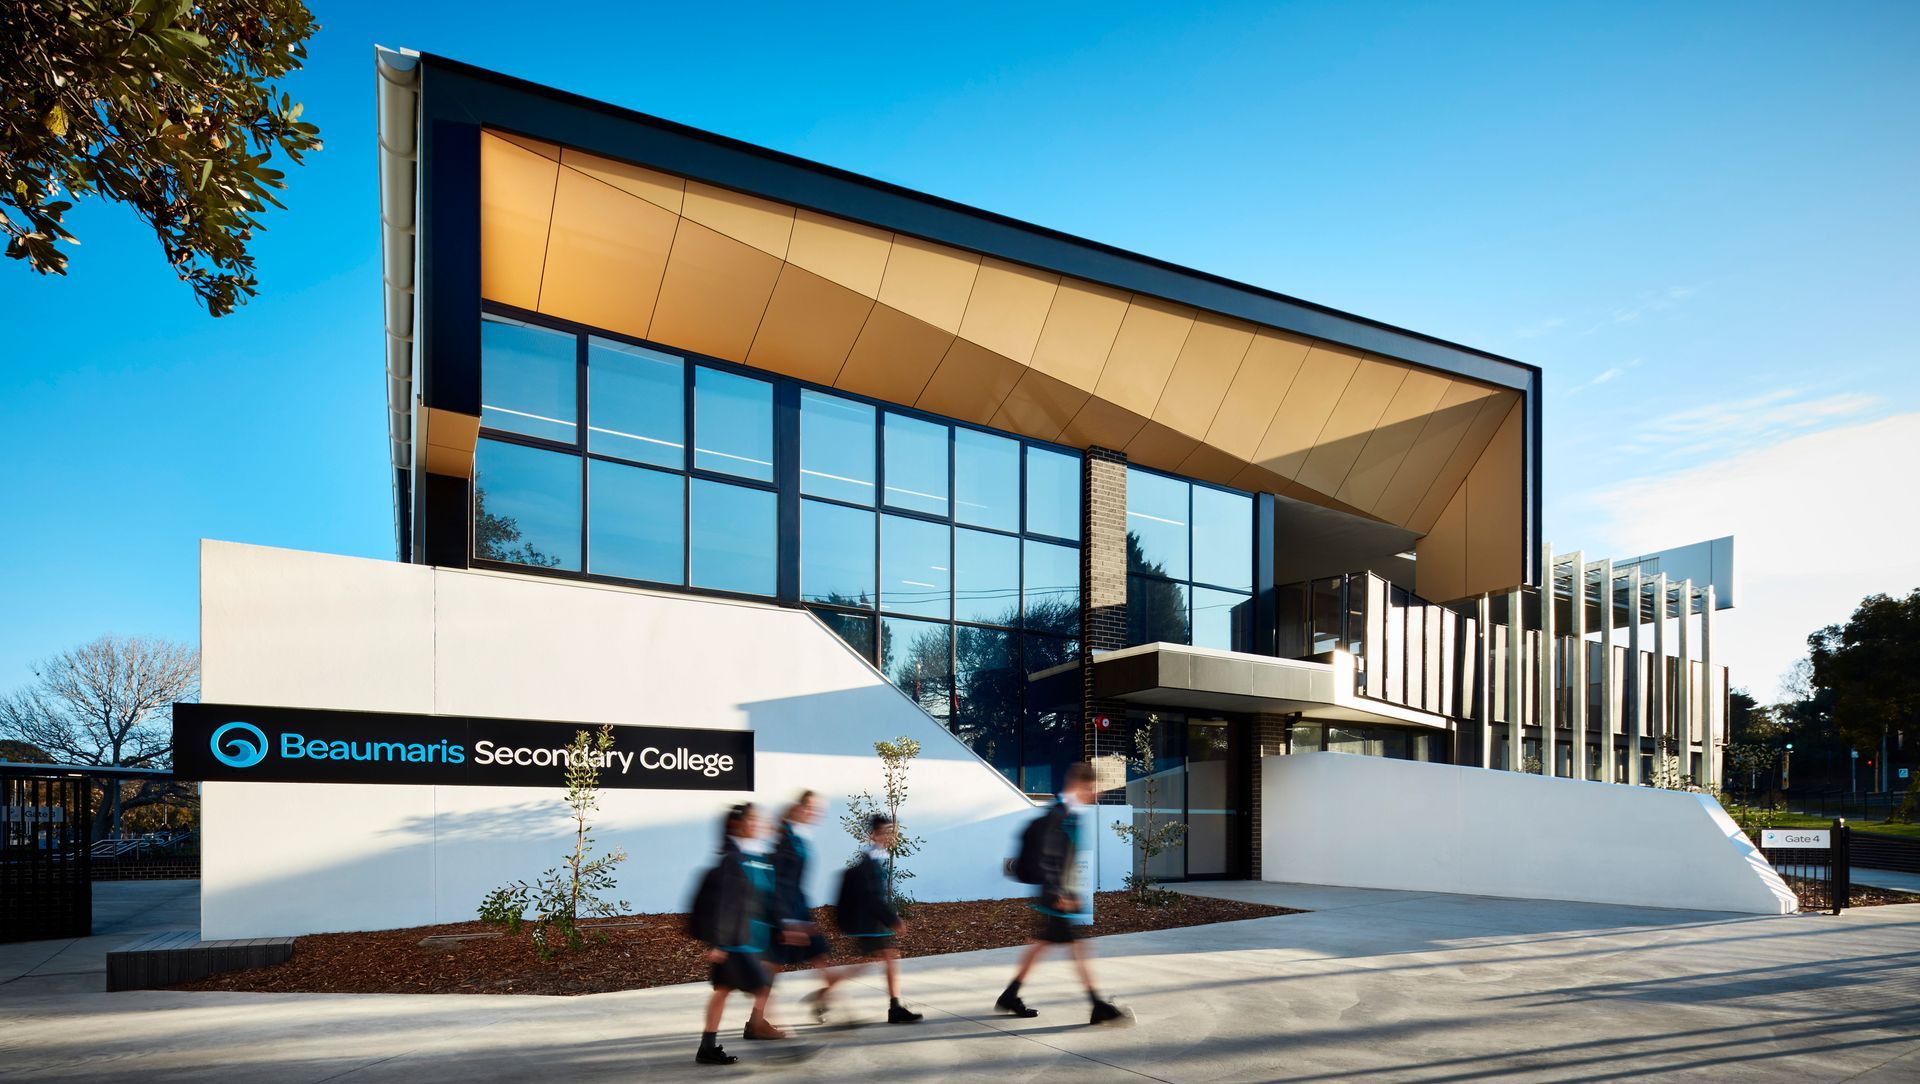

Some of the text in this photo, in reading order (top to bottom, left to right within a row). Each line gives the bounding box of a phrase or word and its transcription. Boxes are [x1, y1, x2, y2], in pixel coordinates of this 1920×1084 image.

[280, 732, 734, 777] Beaumaris Secondary College
[1785, 835, 1821, 843] Gate 4
